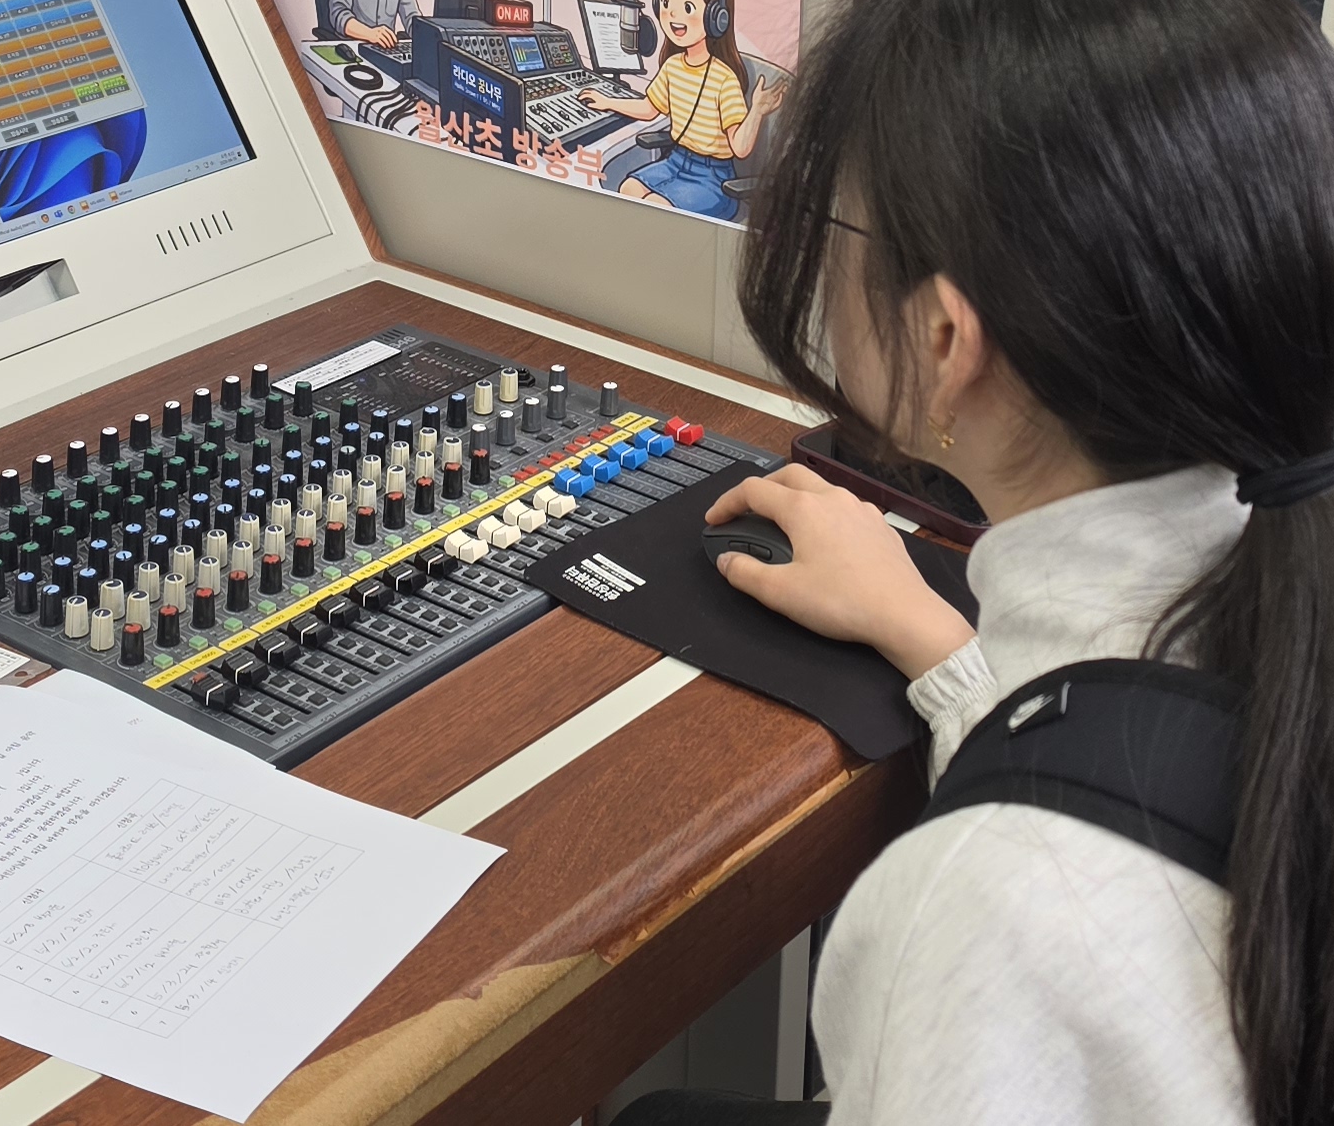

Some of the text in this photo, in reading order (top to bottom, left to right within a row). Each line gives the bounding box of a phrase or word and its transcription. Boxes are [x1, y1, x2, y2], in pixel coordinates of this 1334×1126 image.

[496, 5, 530, 22] ON AIR
[452, 64, 477, 86] 라디오
[477, 78, 503, 101] 꿈나무
[413, 99, 609, 187] 월산초 방송부
[5, 741, 22, 753] 아침
[13, 784, 53, 815] 마치겠습니다.
[30, 843, 48, 855] 되길
[46, 826, 69, 843] 바라며
[66, 809, 90, 825] 방송을
[88, 776, 127, 808] 마치겠습니다.
[33, 799, 57, 816] 빛나길
[54, 778, 85, 800] 바랍니다.
[21, 832, 39, 845] 되길
[22, 888, 45, 904] 신청자
[116, 812, 138, 829] 신청곡
